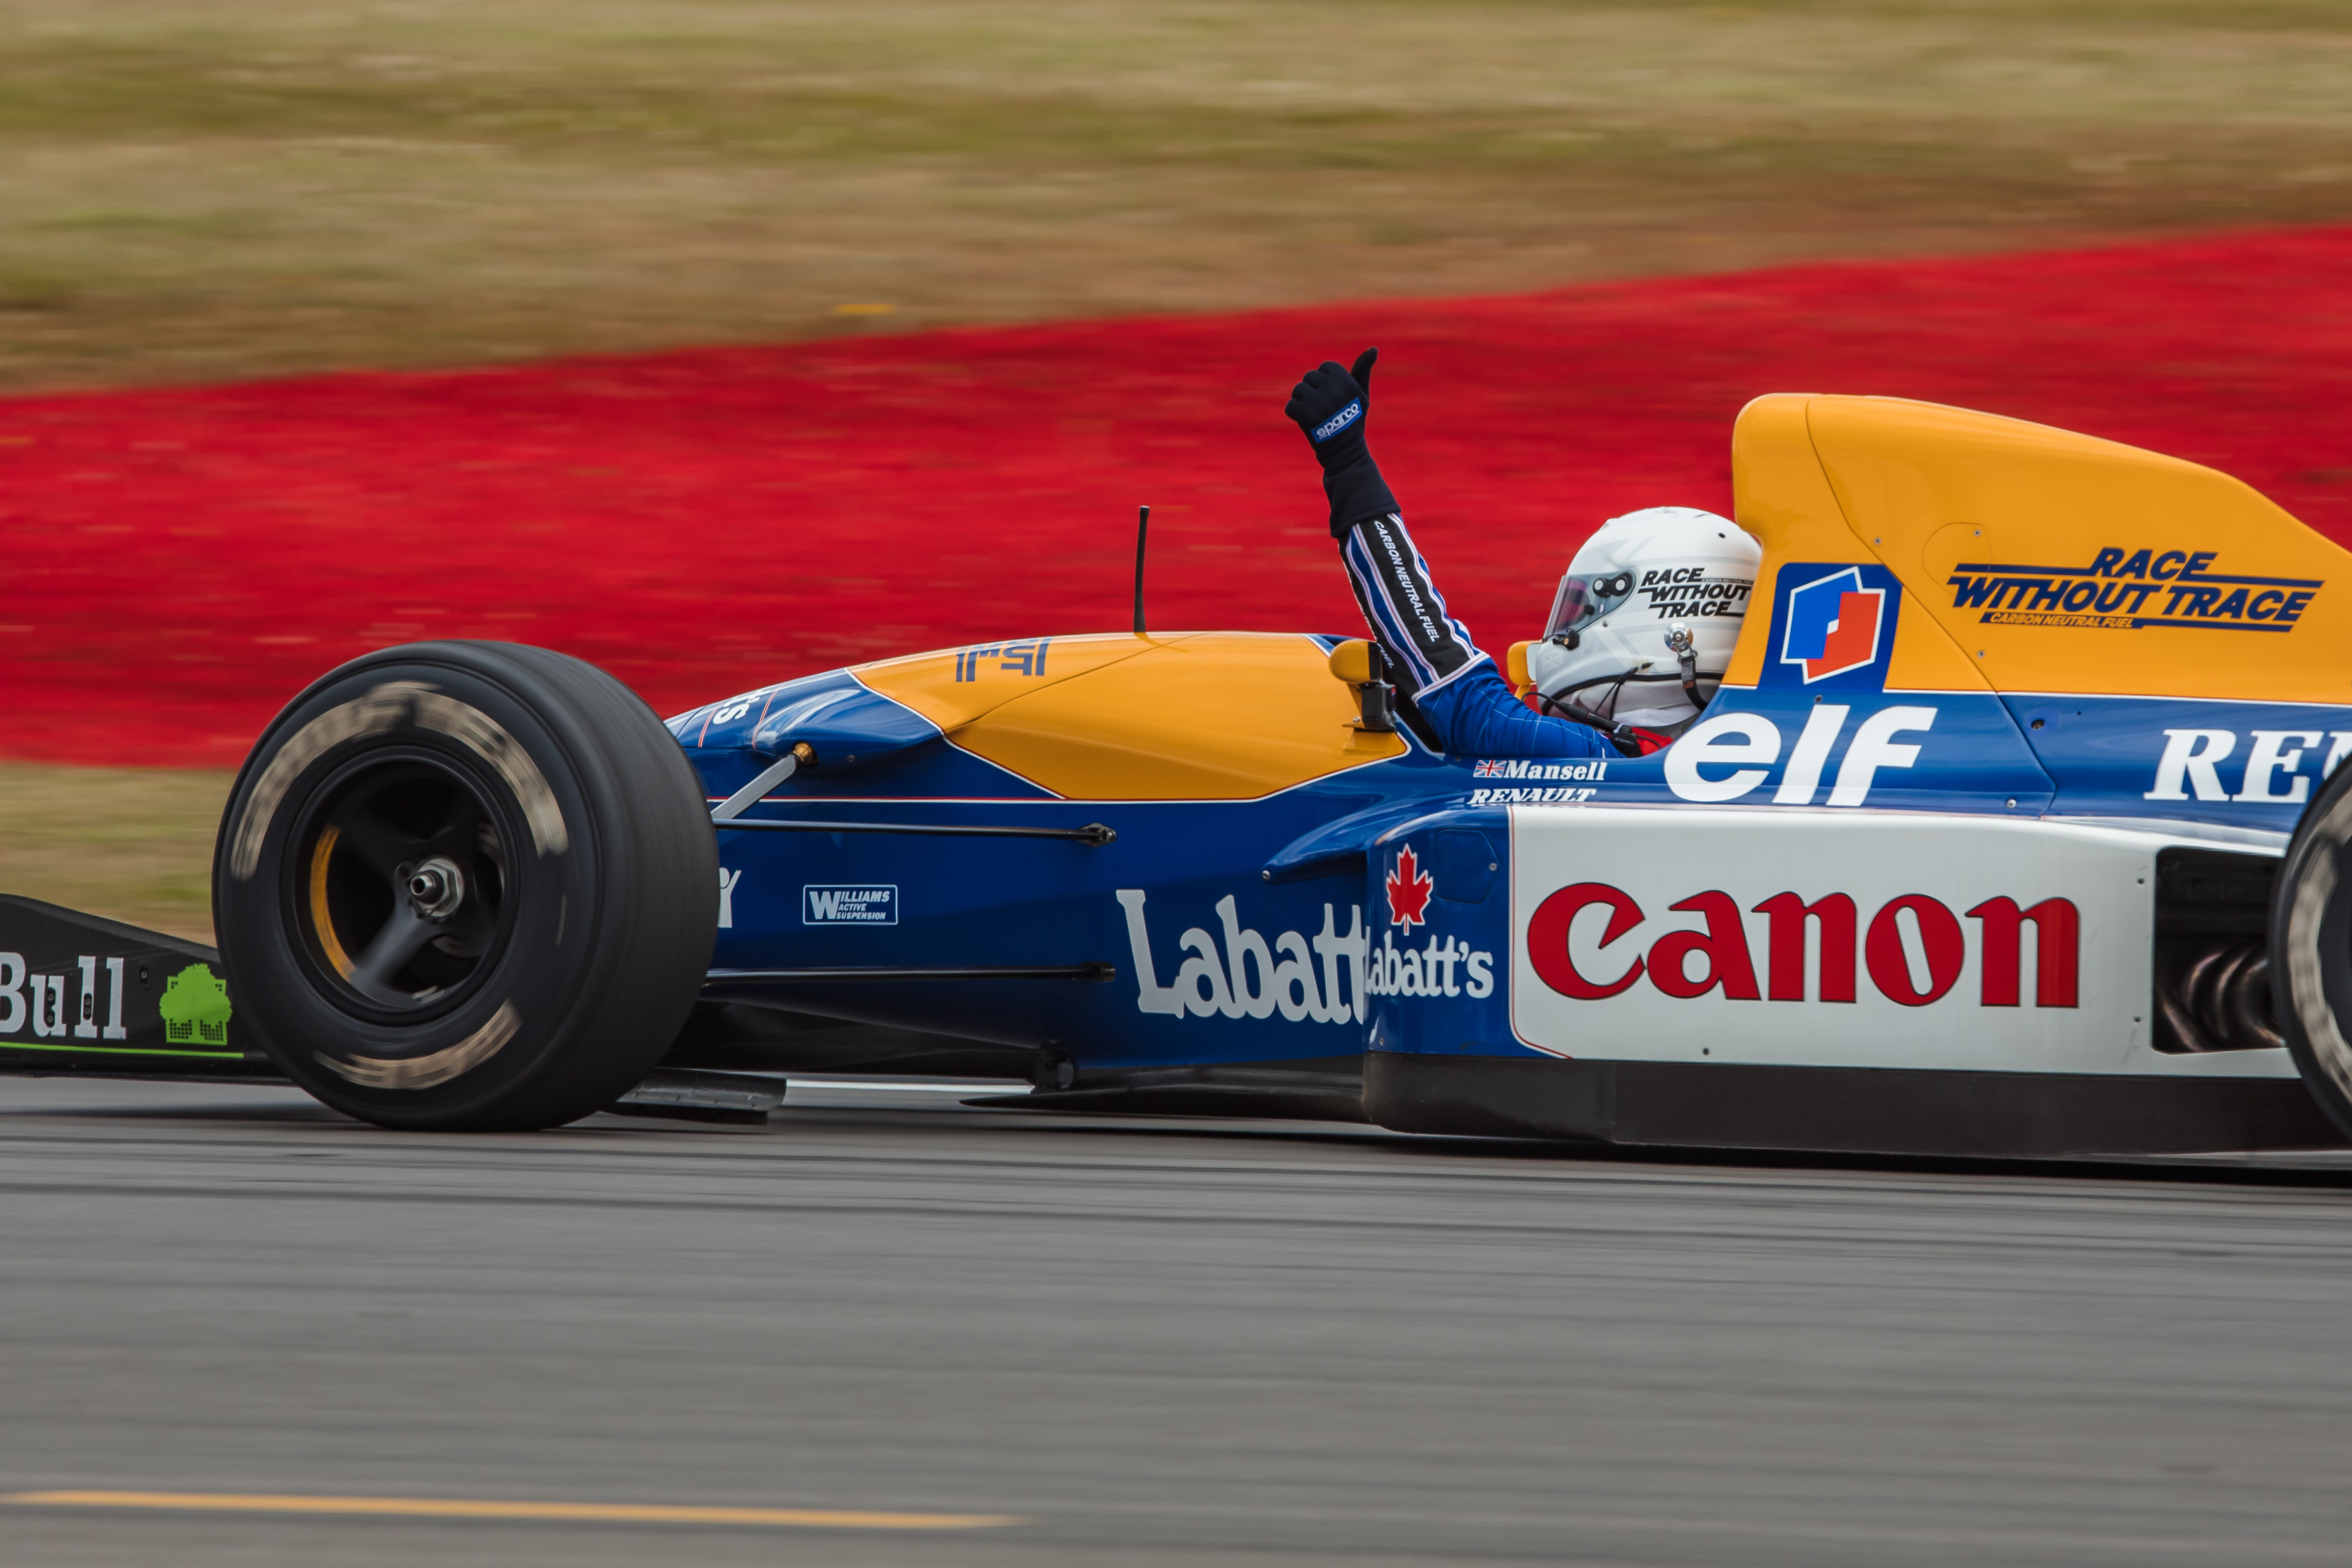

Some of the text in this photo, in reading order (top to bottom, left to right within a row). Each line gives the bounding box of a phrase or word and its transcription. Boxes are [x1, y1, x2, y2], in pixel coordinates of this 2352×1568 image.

[2093, 547, 2219, 582] RACE
[1374, 520, 1440, 642] CARBON NEUTRAL FUEL
[1640, 567, 1705, 587] RACE
[1637, 583, 1753, 602] WITHOUT
[1947, 574, 2316, 621] WITHOUT TRACE
[1648, 601, 1732, 619] TRACE
[1990, 612, 2134, 628] CARBON NEUTRAL FUEL
[1664, 704, 1938, 806] elf
[1503, 759, 1607, 781] Mansell
[1466, 788, 1597, 804] RENAULT
[809, 891, 891, 920] WILLIAMS
[836, 912, 886, 920] SUSPENSION
[838, 903, 867, 911] ACTIVE
[1527, 882, 2079, 1009] Canon
